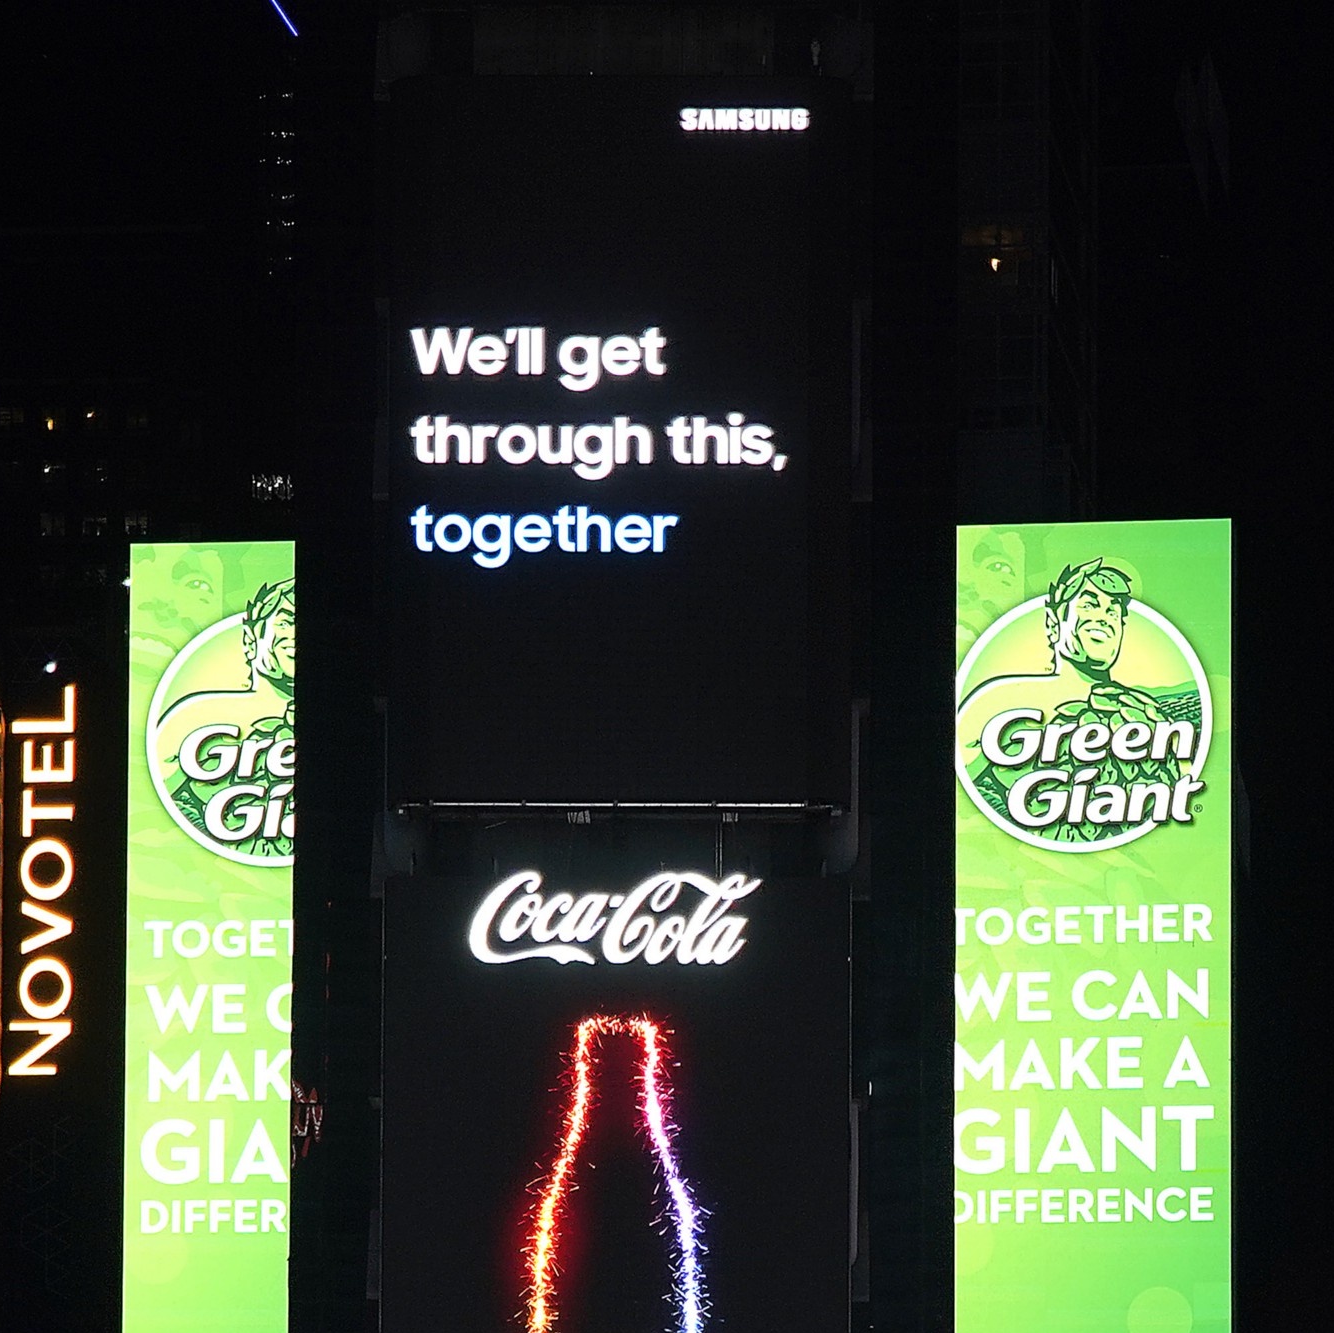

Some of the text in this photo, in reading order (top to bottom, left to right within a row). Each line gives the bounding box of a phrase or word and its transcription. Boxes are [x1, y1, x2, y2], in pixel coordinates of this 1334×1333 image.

[680, 108, 809, 131] SAMSUNG
[410, 327, 668, 392] We'll get
[410, 412, 788, 481] through this,
[410, 505, 679, 569] together
[980, 708, 1195, 767] Green
[1007, 768, 1206, 827] Giant
[8, 684, 78, 1077] NOVOTEL
[469, 870, 763, 965] Coca-Cola
[955, 903, 1213, 947] TOGETHER
[144, 983, 247, 1034] WE
[955, 968, 1209, 1022] WE CAN
[954, 1035, 1210, 1092] MAKE A
[140, 1118, 288, 1185] GIA
[953, 1105, 1215, 1175] GIANT
[140, 1199, 287, 1235] DIFFER
[954, 1186, 1215, 1224] DIFFERENCE
